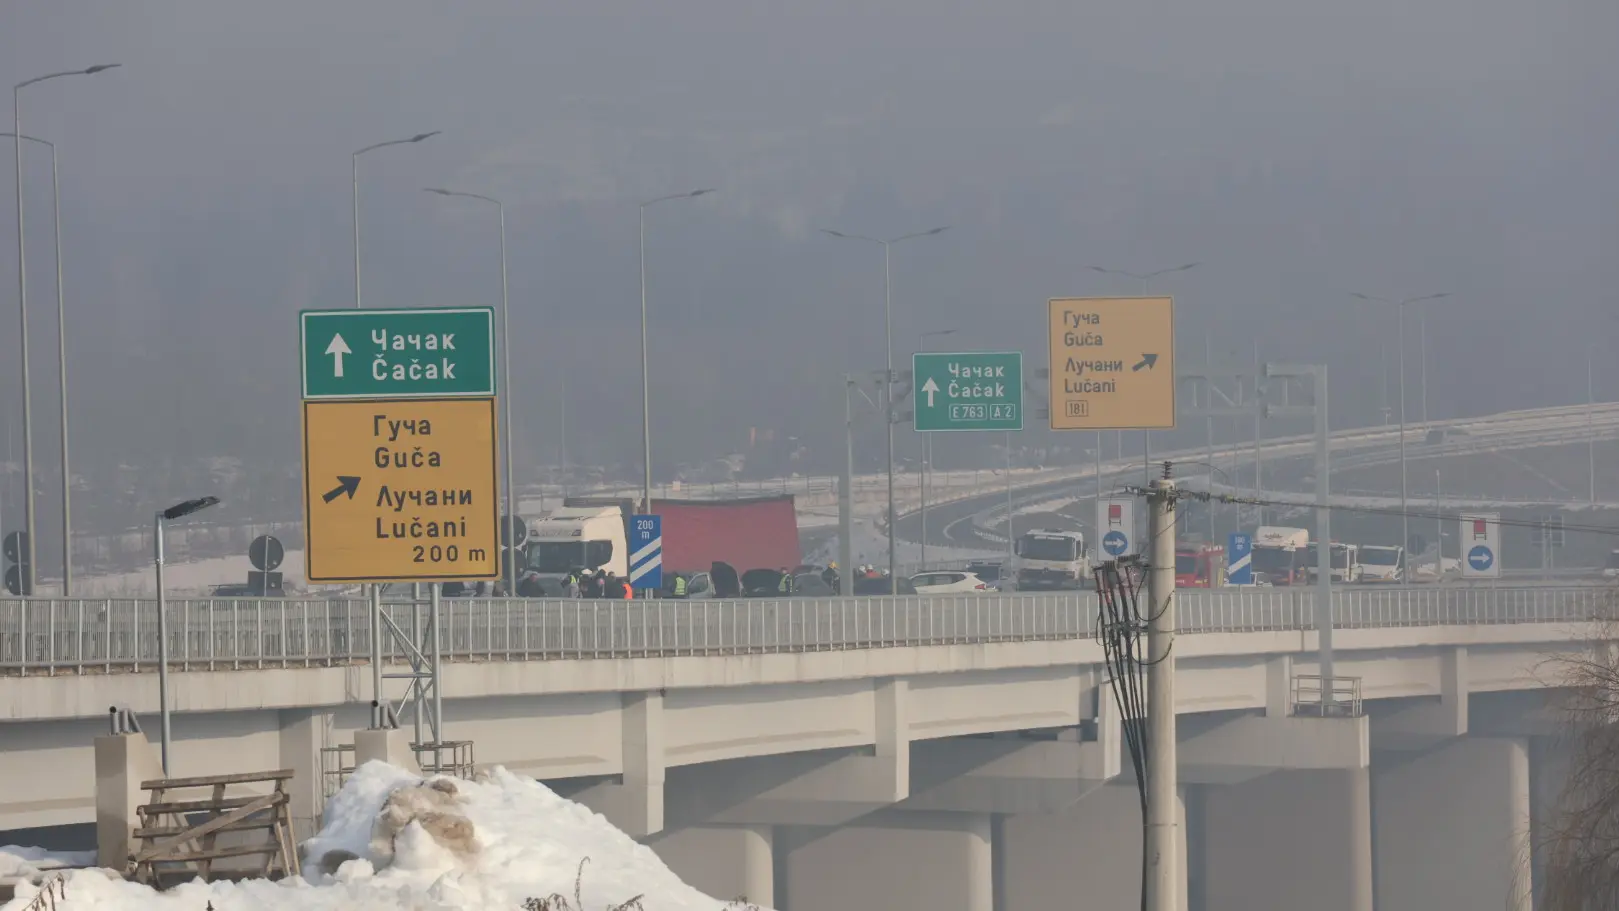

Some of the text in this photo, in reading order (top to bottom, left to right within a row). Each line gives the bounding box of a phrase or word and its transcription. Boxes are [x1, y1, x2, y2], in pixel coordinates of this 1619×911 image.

[1064, 310, 1100, 328] Гуча
[371, 328, 456, 351] Чачак
[1064, 331, 1103, 347] Guča
[372, 354, 456, 380] Čačak
[948, 363, 1005, 378] Чачак
[1065, 357, 1123, 375] Лучани
[948, 379, 1005, 398] Čačak
[1065, 378, 1115, 393] Lučani
[962, 406, 984, 418] 763
[1004, 405, 1011, 418] 2
[1069, 402, 1085, 415] 181
[373, 414, 432, 441] Гуча
[374, 446, 441, 468] Guča
[376, 485, 472, 512] Лучани
[376, 516, 466, 539] Lučani
[637, 520, 654, 530] 200
[641, 531, 650, 540] m
[412, 545, 486, 563] 200 m
